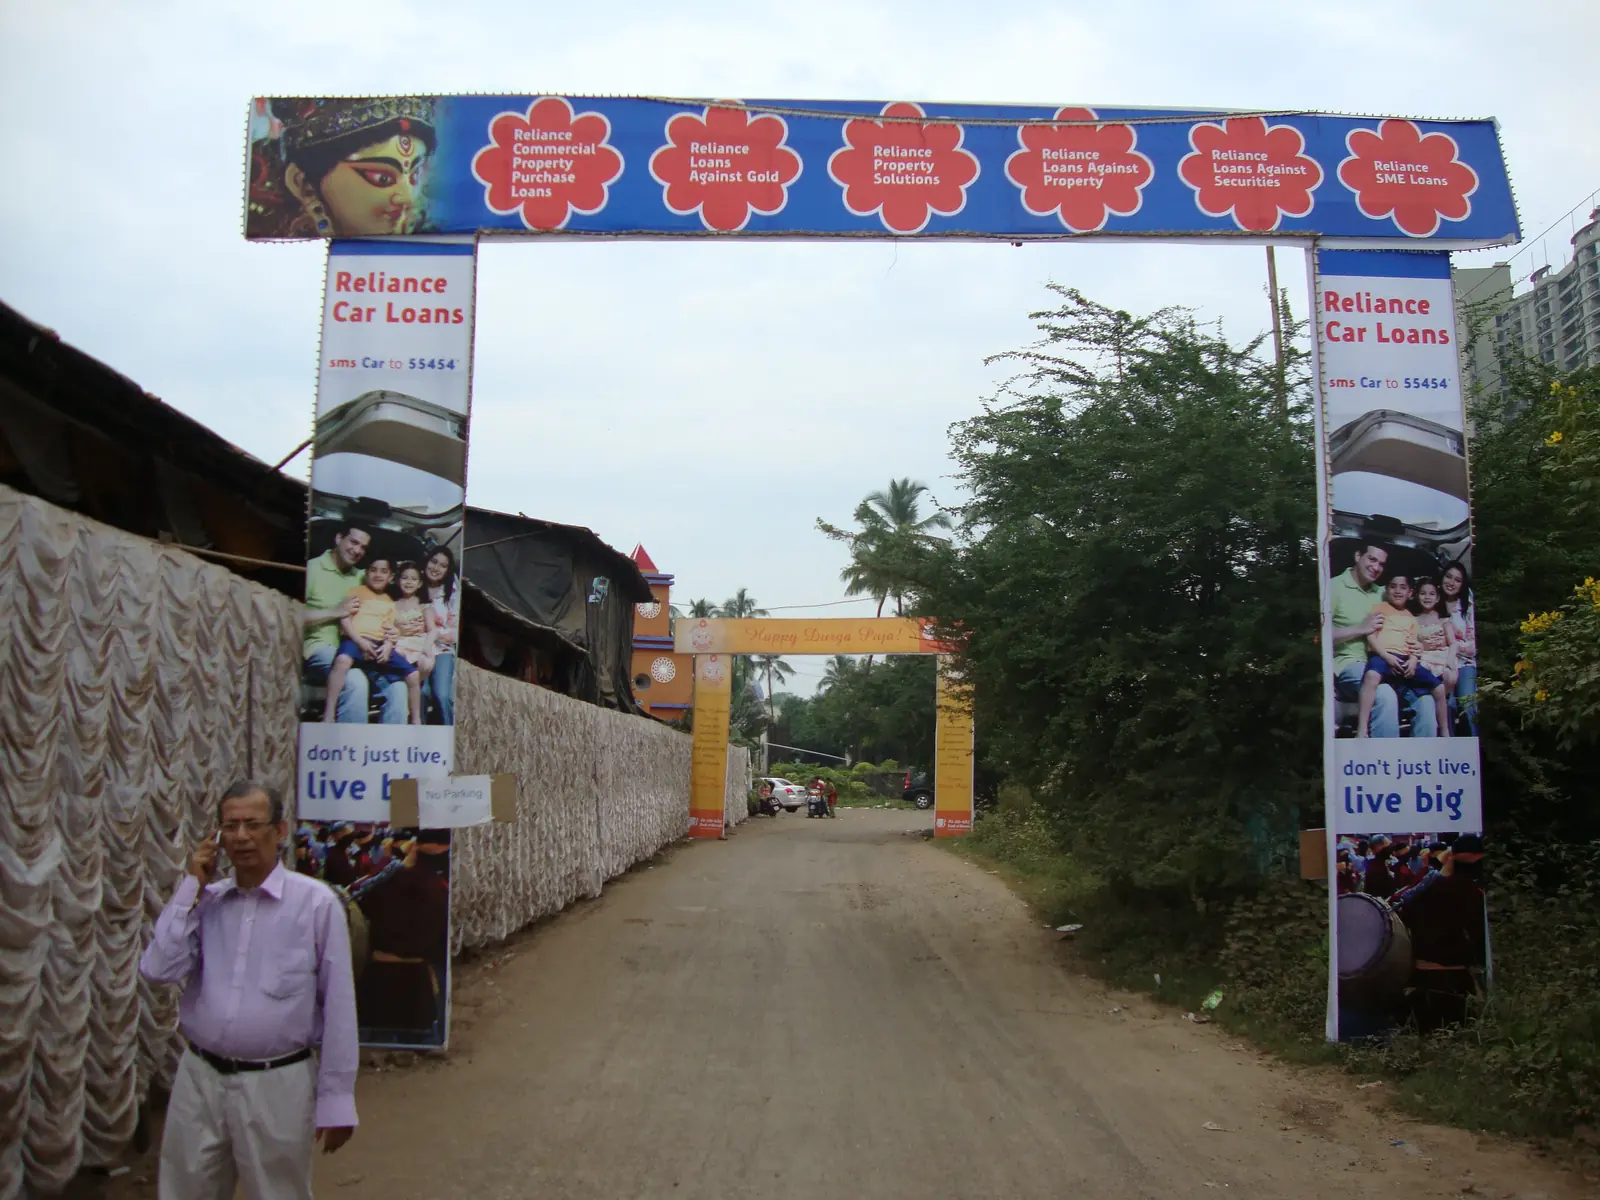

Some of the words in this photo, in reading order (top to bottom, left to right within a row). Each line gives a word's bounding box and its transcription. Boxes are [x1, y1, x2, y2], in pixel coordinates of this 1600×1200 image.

[513, 128, 573, 141] Reliance
[512, 142, 596, 155] Commercial
[690, 142, 750, 154] Reliance
[873, 145, 933, 157] Reliance
[1042, 148, 1100, 160] Reliance
[690, 156, 731, 168] Loans
[1211, 149, 1268, 162] Reliance
[512, 156, 574, 171] Property
[873, 159, 935, 173] Property
[1043, 161, 1083, 173] Loans
[1087, 162, 1139, 176] Against
[1213, 162, 1253, 174] Loans
[1256, 163, 1307, 177] Against
[1374, 160, 1429, 173] Reliance
[511, 171, 576, 183] Purchase
[689, 170, 743, 185] Against
[746, 170, 780, 183] Gold
[873, 172, 941, 185] Solutions
[1044, 175, 1104, 189] Property
[1214, 175, 1281, 188] Securities
[1376, 173, 1406, 184] SME
[1410, 174, 1448, 186] Loans
[511, 185, 552, 197] Loans
[335, 271, 448, 293] Reliance
[1324, 290, 1430, 315] Reliance
[332, 300, 377, 323] Car
[385, 301, 464, 324] Loans
[1325, 320, 1367, 343] Car
[1376, 322, 1450, 345] Loans
[328, 358, 357, 369] sms
[361, 356, 385, 369] Car
[389, 358, 403, 370] to
[1329, 378, 1356, 388] sms
[1360, 376, 1382, 389] Car
[1386, 379, 1399, 389] to
[745, 627, 798, 647] Happy
[804, 628, 852, 645] Durga
[858, 626, 903, 645] Puja!
[307, 745, 356, 762] don't
[362, 746, 400, 766] just
[407, 746, 448, 766] live,
[1343, 759, 1391, 776] don't
[1396, 759, 1432, 780] just
[1438, 758, 1476, 777] live,
[307, 771, 367, 801] live
[425, 790, 441, 800] No
[443, 788, 484, 800] Parking
[1344, 785, 1402, 814] live
[1415, 784, 1464, 821] big
